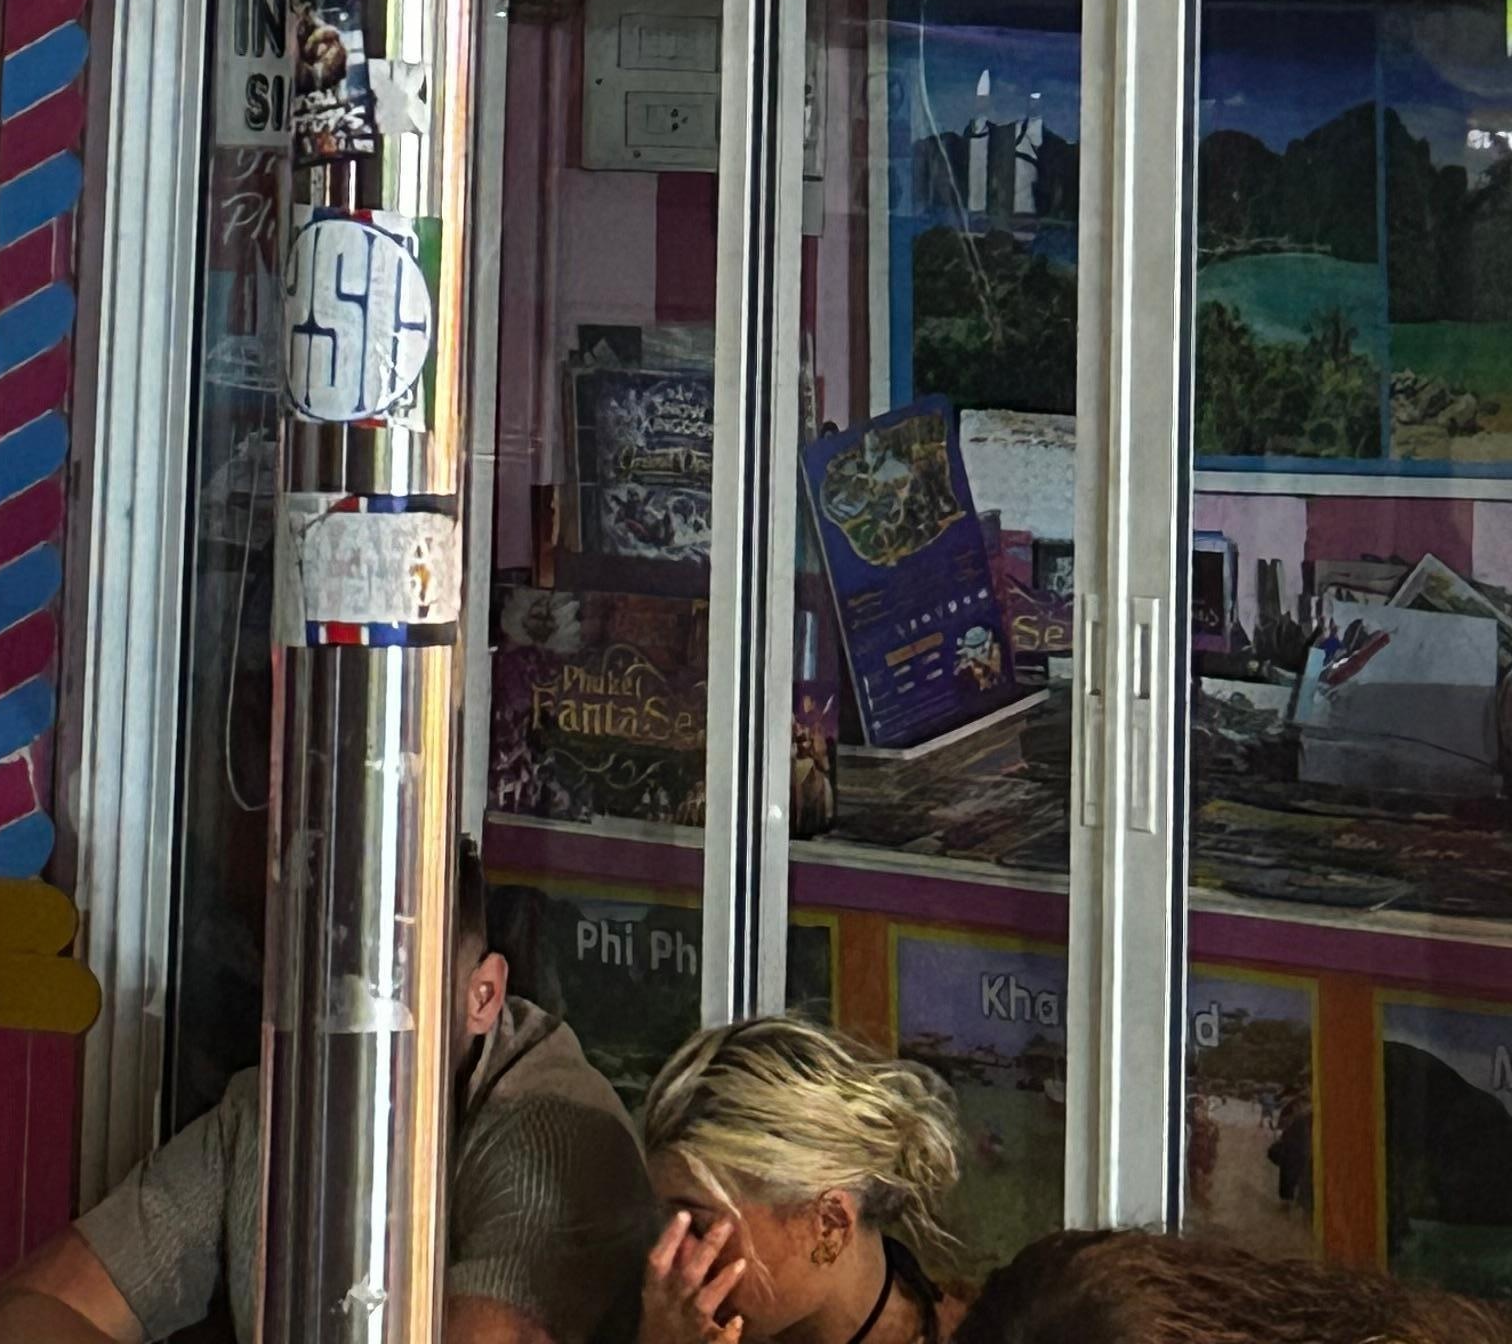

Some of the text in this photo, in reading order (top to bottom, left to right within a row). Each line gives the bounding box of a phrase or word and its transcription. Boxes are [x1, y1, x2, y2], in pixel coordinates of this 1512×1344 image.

[245, 73, 291, 132] SI
[563, 665, 643, 700] Phuket
[577, 919, 634, 967] Phi
[980, 973, 1061, 1026] Kha
